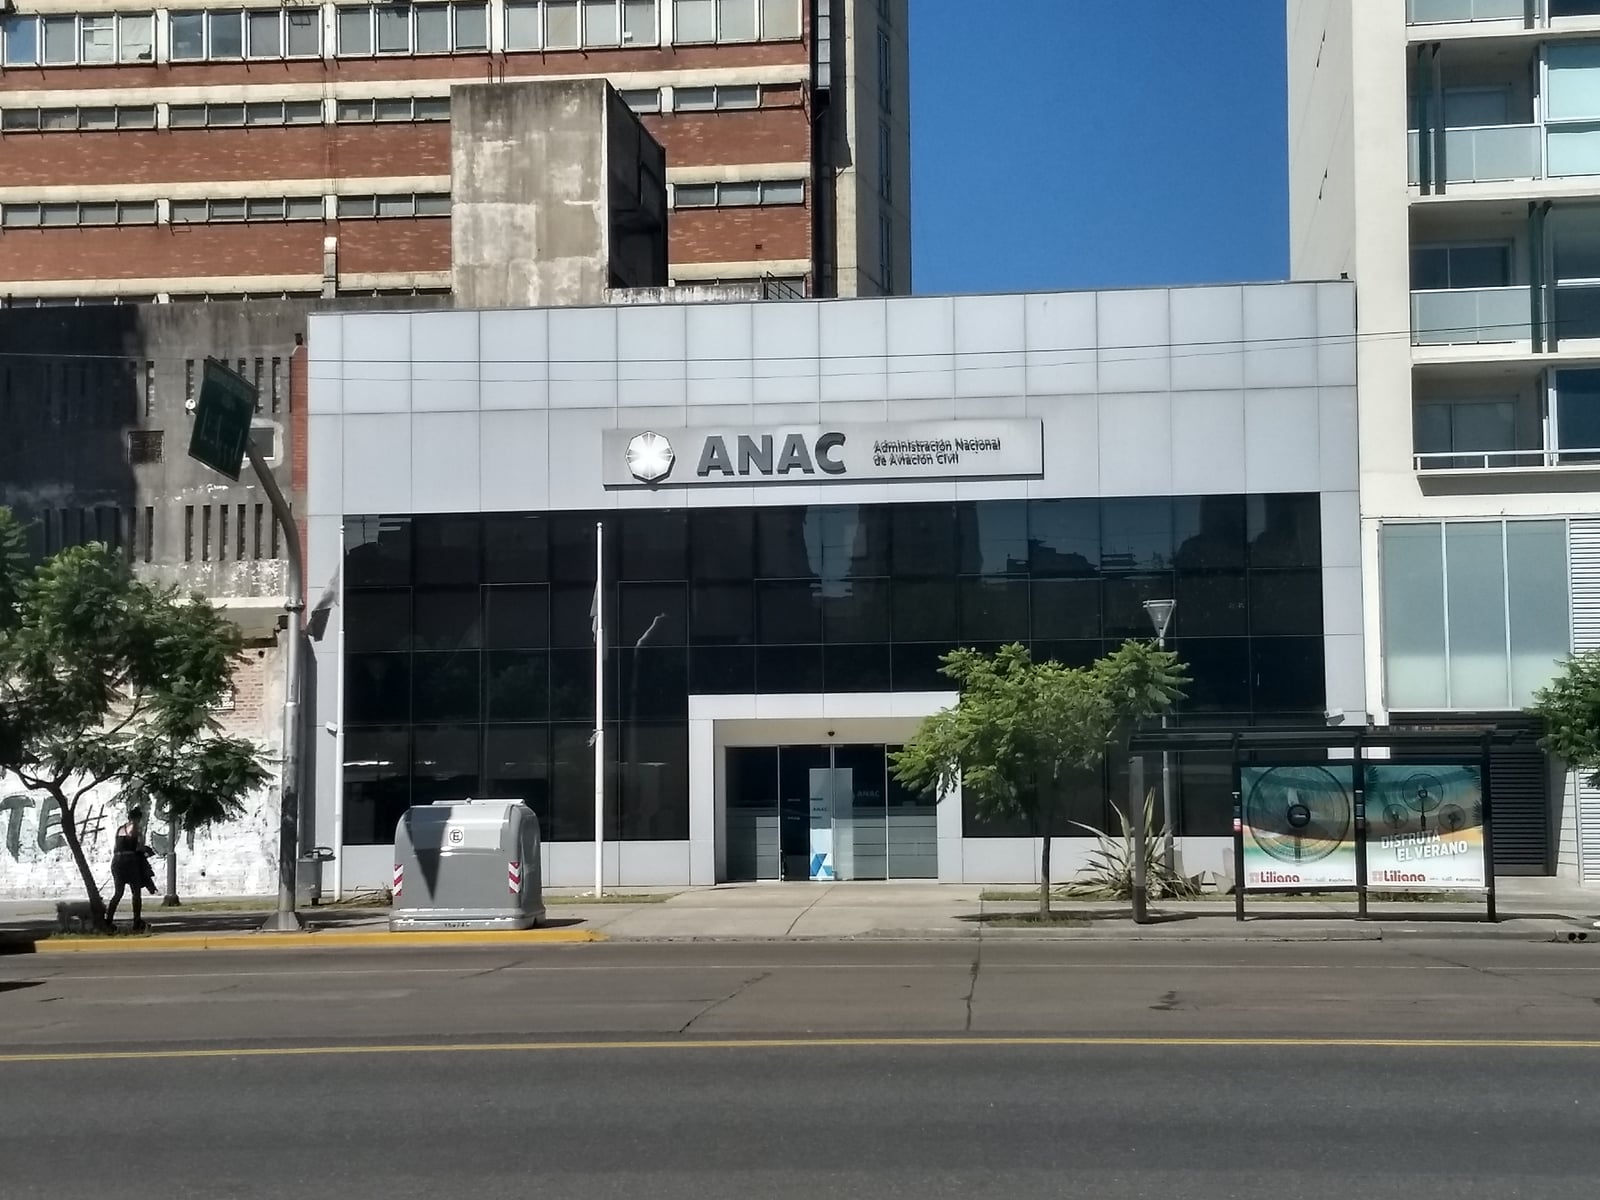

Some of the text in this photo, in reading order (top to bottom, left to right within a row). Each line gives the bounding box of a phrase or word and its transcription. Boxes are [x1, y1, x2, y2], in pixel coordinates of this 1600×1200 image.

[873, 437, 1001, 453] Administración Nacional
[698, 432, 846, 476] ANAC
[873, 451, 959, 466] de Aviación Civil
[1397, 840, 1468, 862] EL VERANO
[1260, 871, 1300, 883] Liliana
[1383, 870, 1426, 882] Liliana
